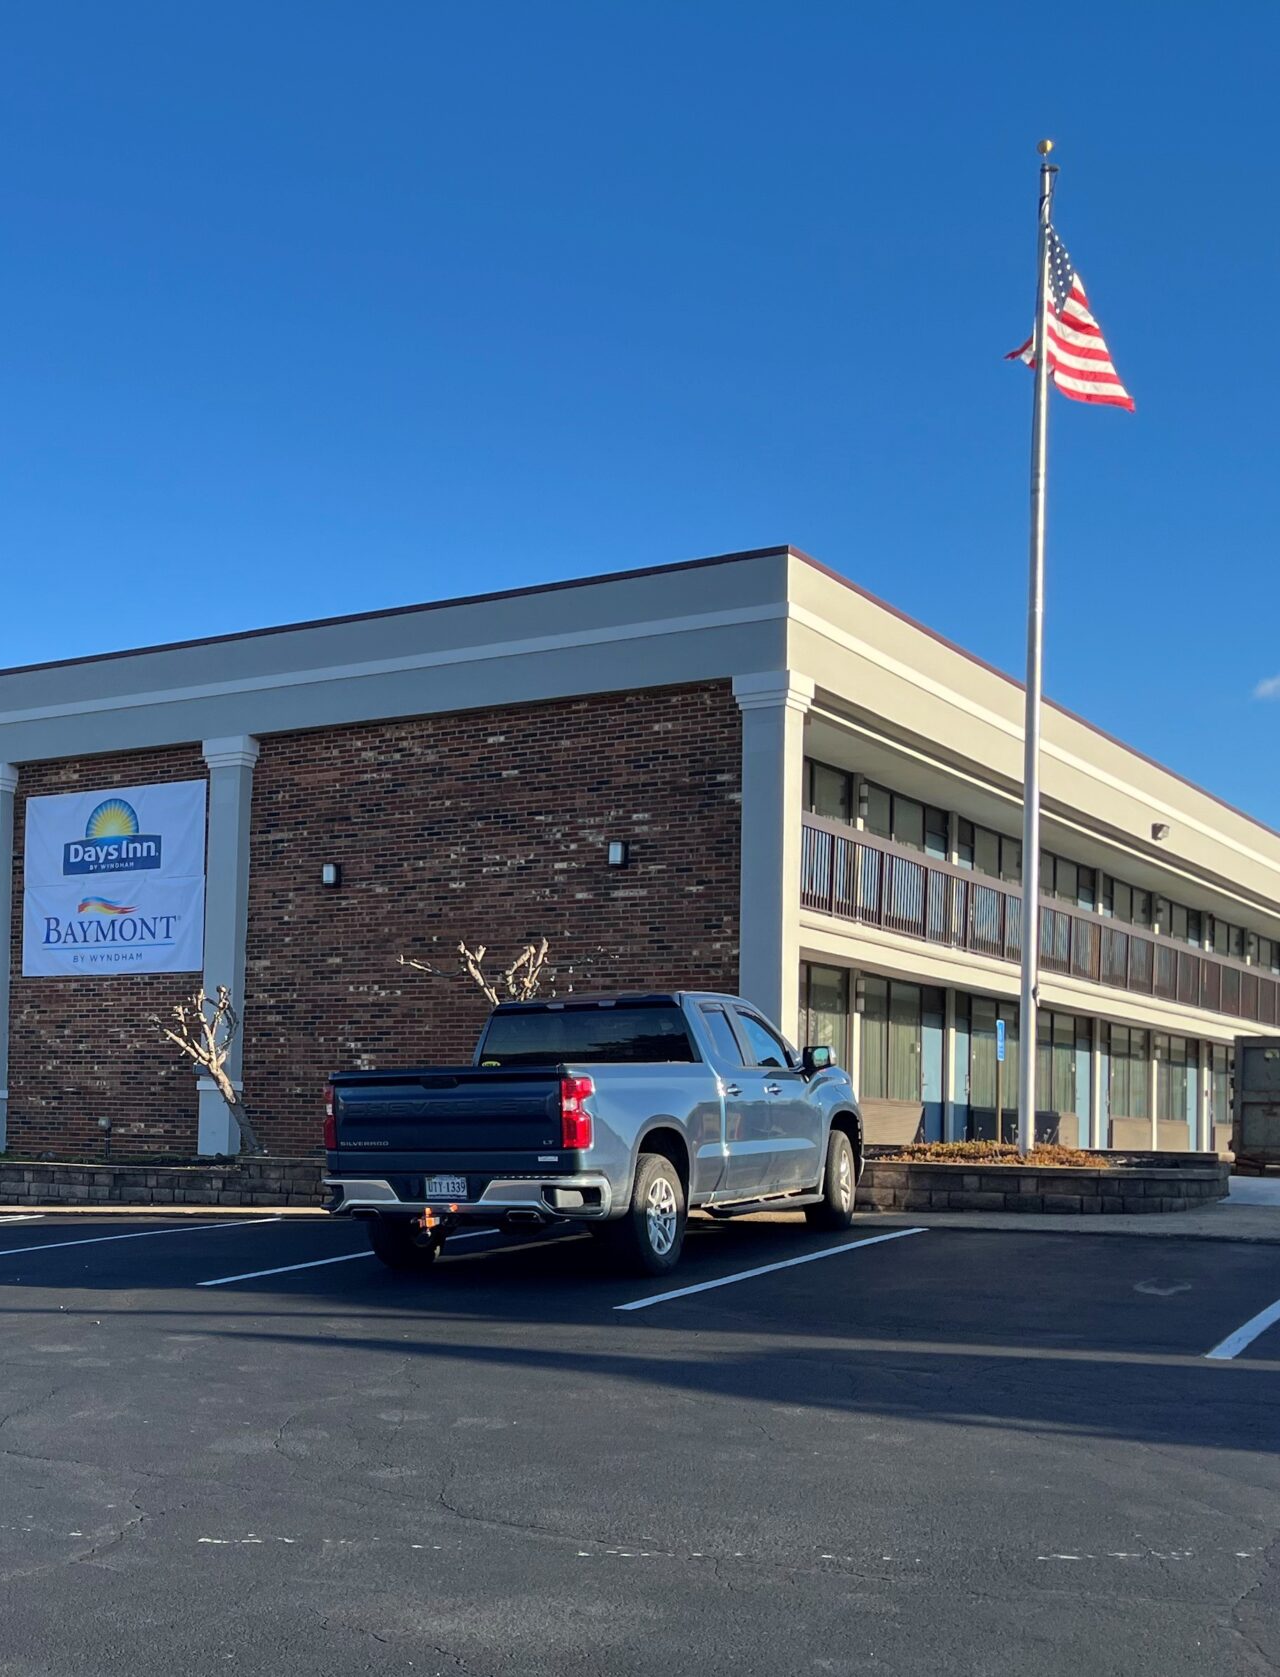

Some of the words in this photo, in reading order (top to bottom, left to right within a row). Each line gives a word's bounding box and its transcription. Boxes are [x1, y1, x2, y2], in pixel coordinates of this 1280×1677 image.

[69, 844, 118, 863] Days
[121, 840, 156, 859] Inn
[42, 915, 177, 944] BAYMONT
[73, 954, 85, 963] BY
[90, 953, 143, 962] WYNDHAM
